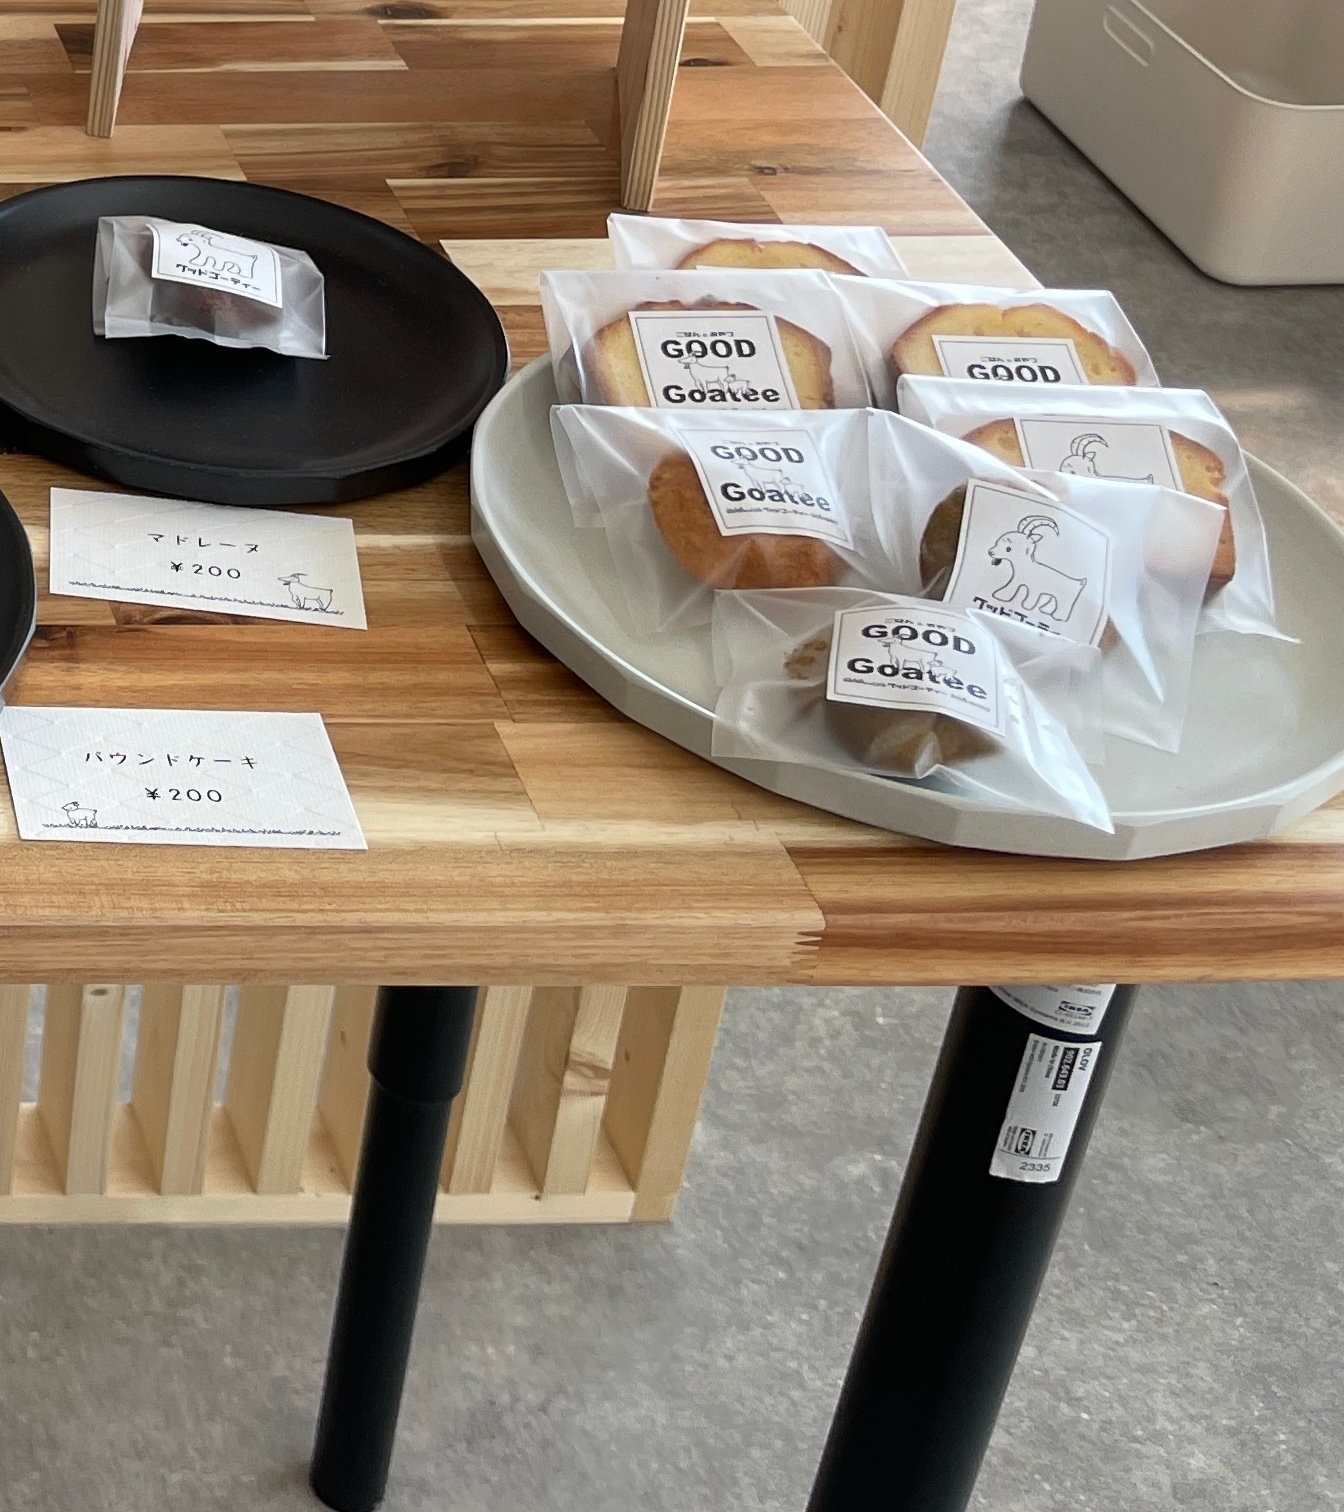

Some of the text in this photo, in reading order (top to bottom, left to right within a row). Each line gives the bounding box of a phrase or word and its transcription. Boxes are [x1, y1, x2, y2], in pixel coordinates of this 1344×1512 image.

[661, 339, 756, 358] GOOD
[966, 363, 1061, 383] GOOD
[662, 384, 780, 404] Goatee
[710, 445, 805, 464] GOOD
[720, 482, 831, 512] Goatee
[147, 533, 259, 554] マドレーヌ
[170, 561, 241, 580] ¥200
[862, 624, 976, 655] GOOD
[846, 657, 989, 700] Goatee
[85, 751, 257, 770] パウンドケーキ
[144, 787, 223, 803] ¥200
[1018, 1128, 1034, 1154] IKEA
